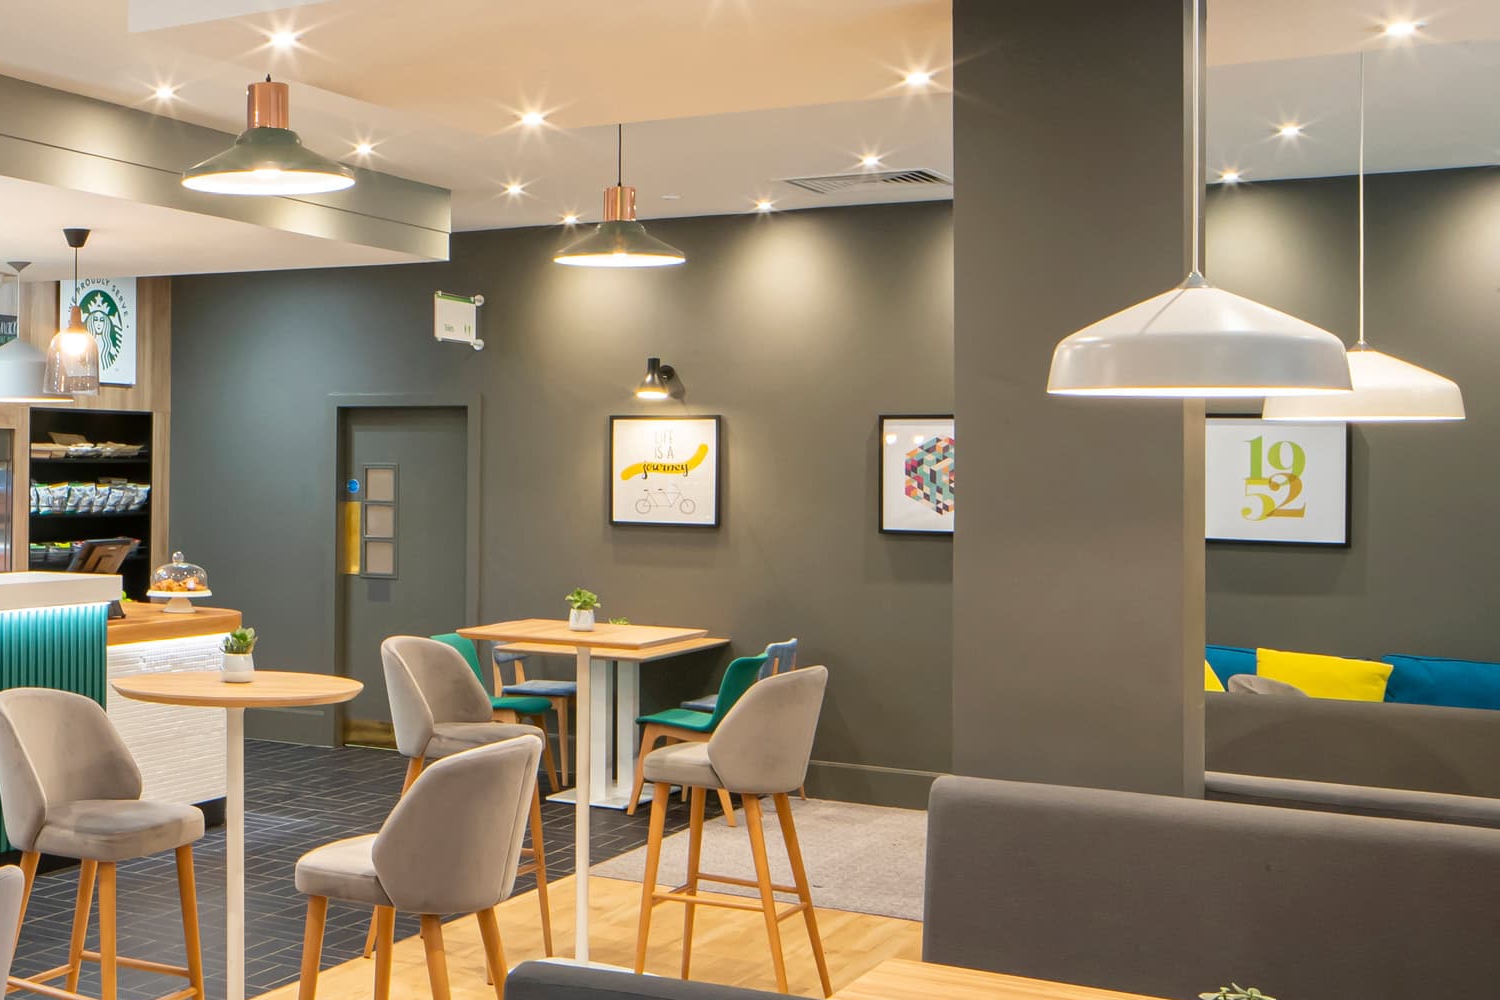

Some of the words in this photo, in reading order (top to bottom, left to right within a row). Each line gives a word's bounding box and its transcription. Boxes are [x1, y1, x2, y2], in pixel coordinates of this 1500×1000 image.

[76, 278, 110, 294] PROUDLY
[111, 285, 129, 317] SERVE
[654, 446, 663, 460] IS
[667, 445, 675, 460] A
[641, 461, 689, 480] journey
